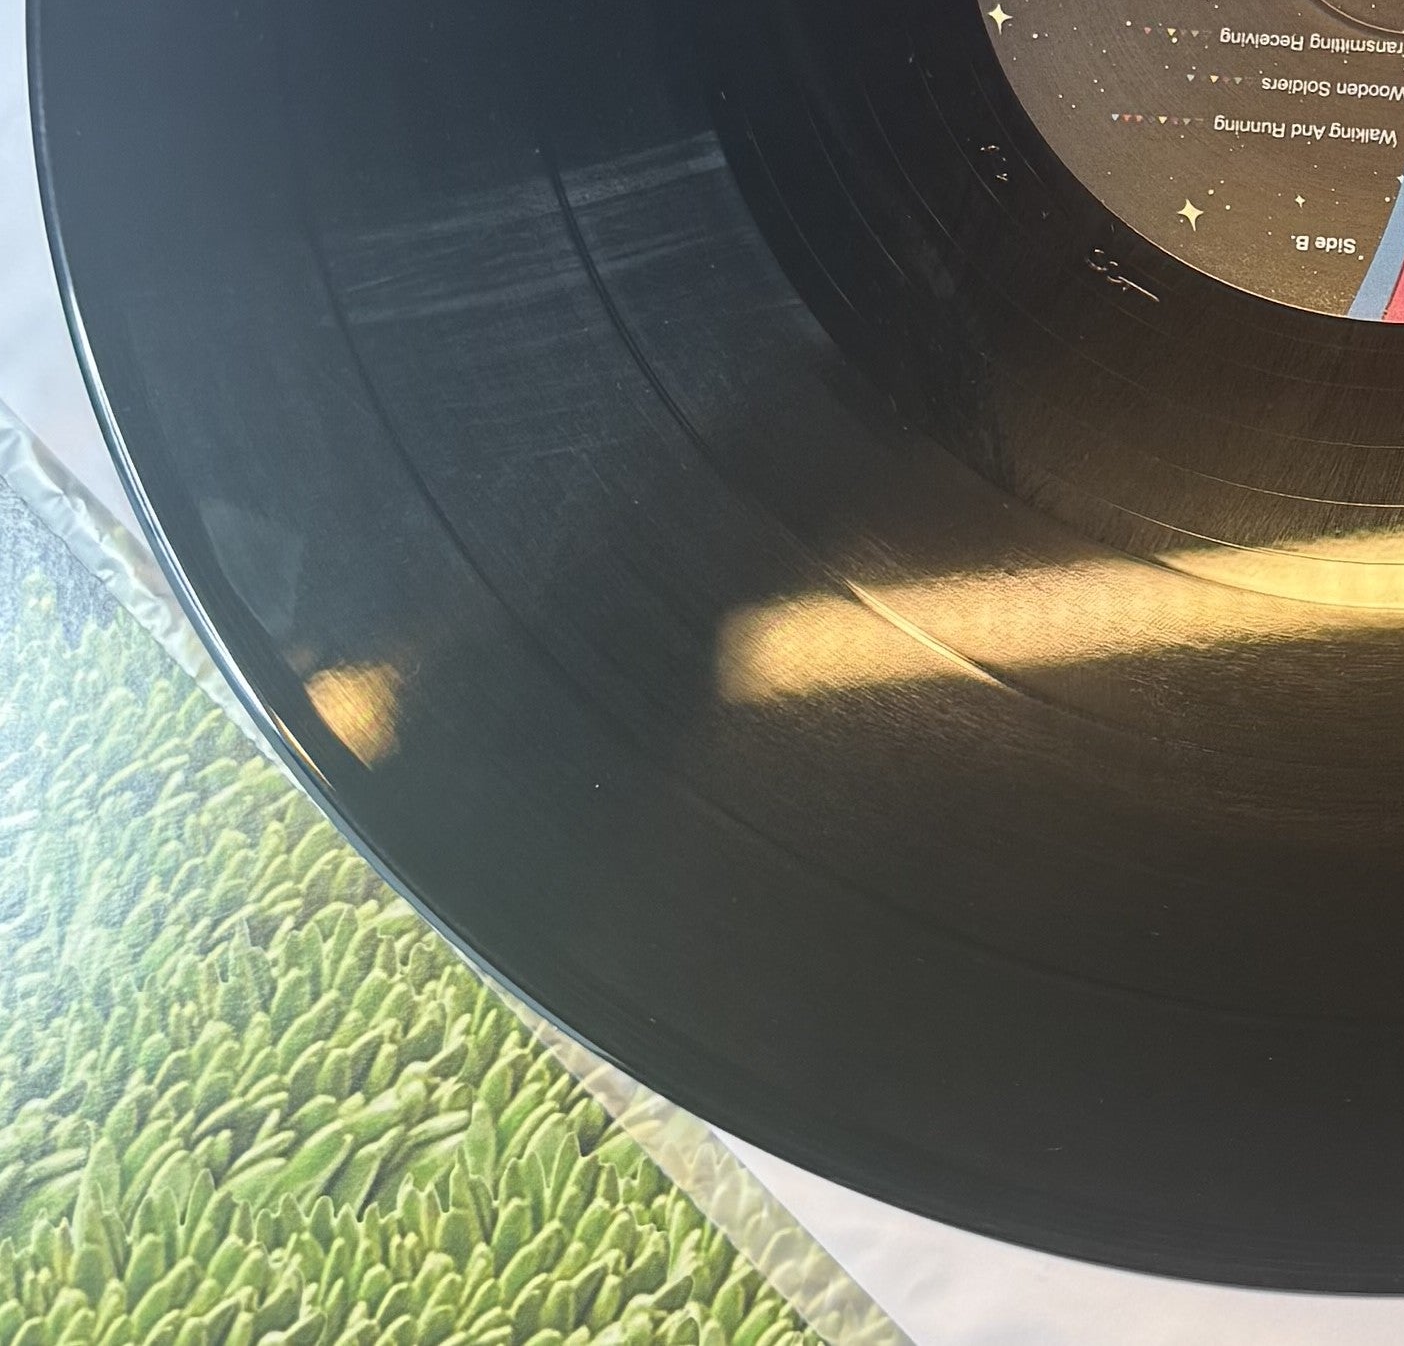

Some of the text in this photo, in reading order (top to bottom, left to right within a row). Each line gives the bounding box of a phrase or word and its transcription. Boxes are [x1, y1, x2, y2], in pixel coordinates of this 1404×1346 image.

[1219, 27, 1304, 51] Receiving
[1261, 77, 1331, 97] Soldiers
[1213, 115, 1397, 148] Walking And Running
[1290, 235, 1357, 254] Side B.
